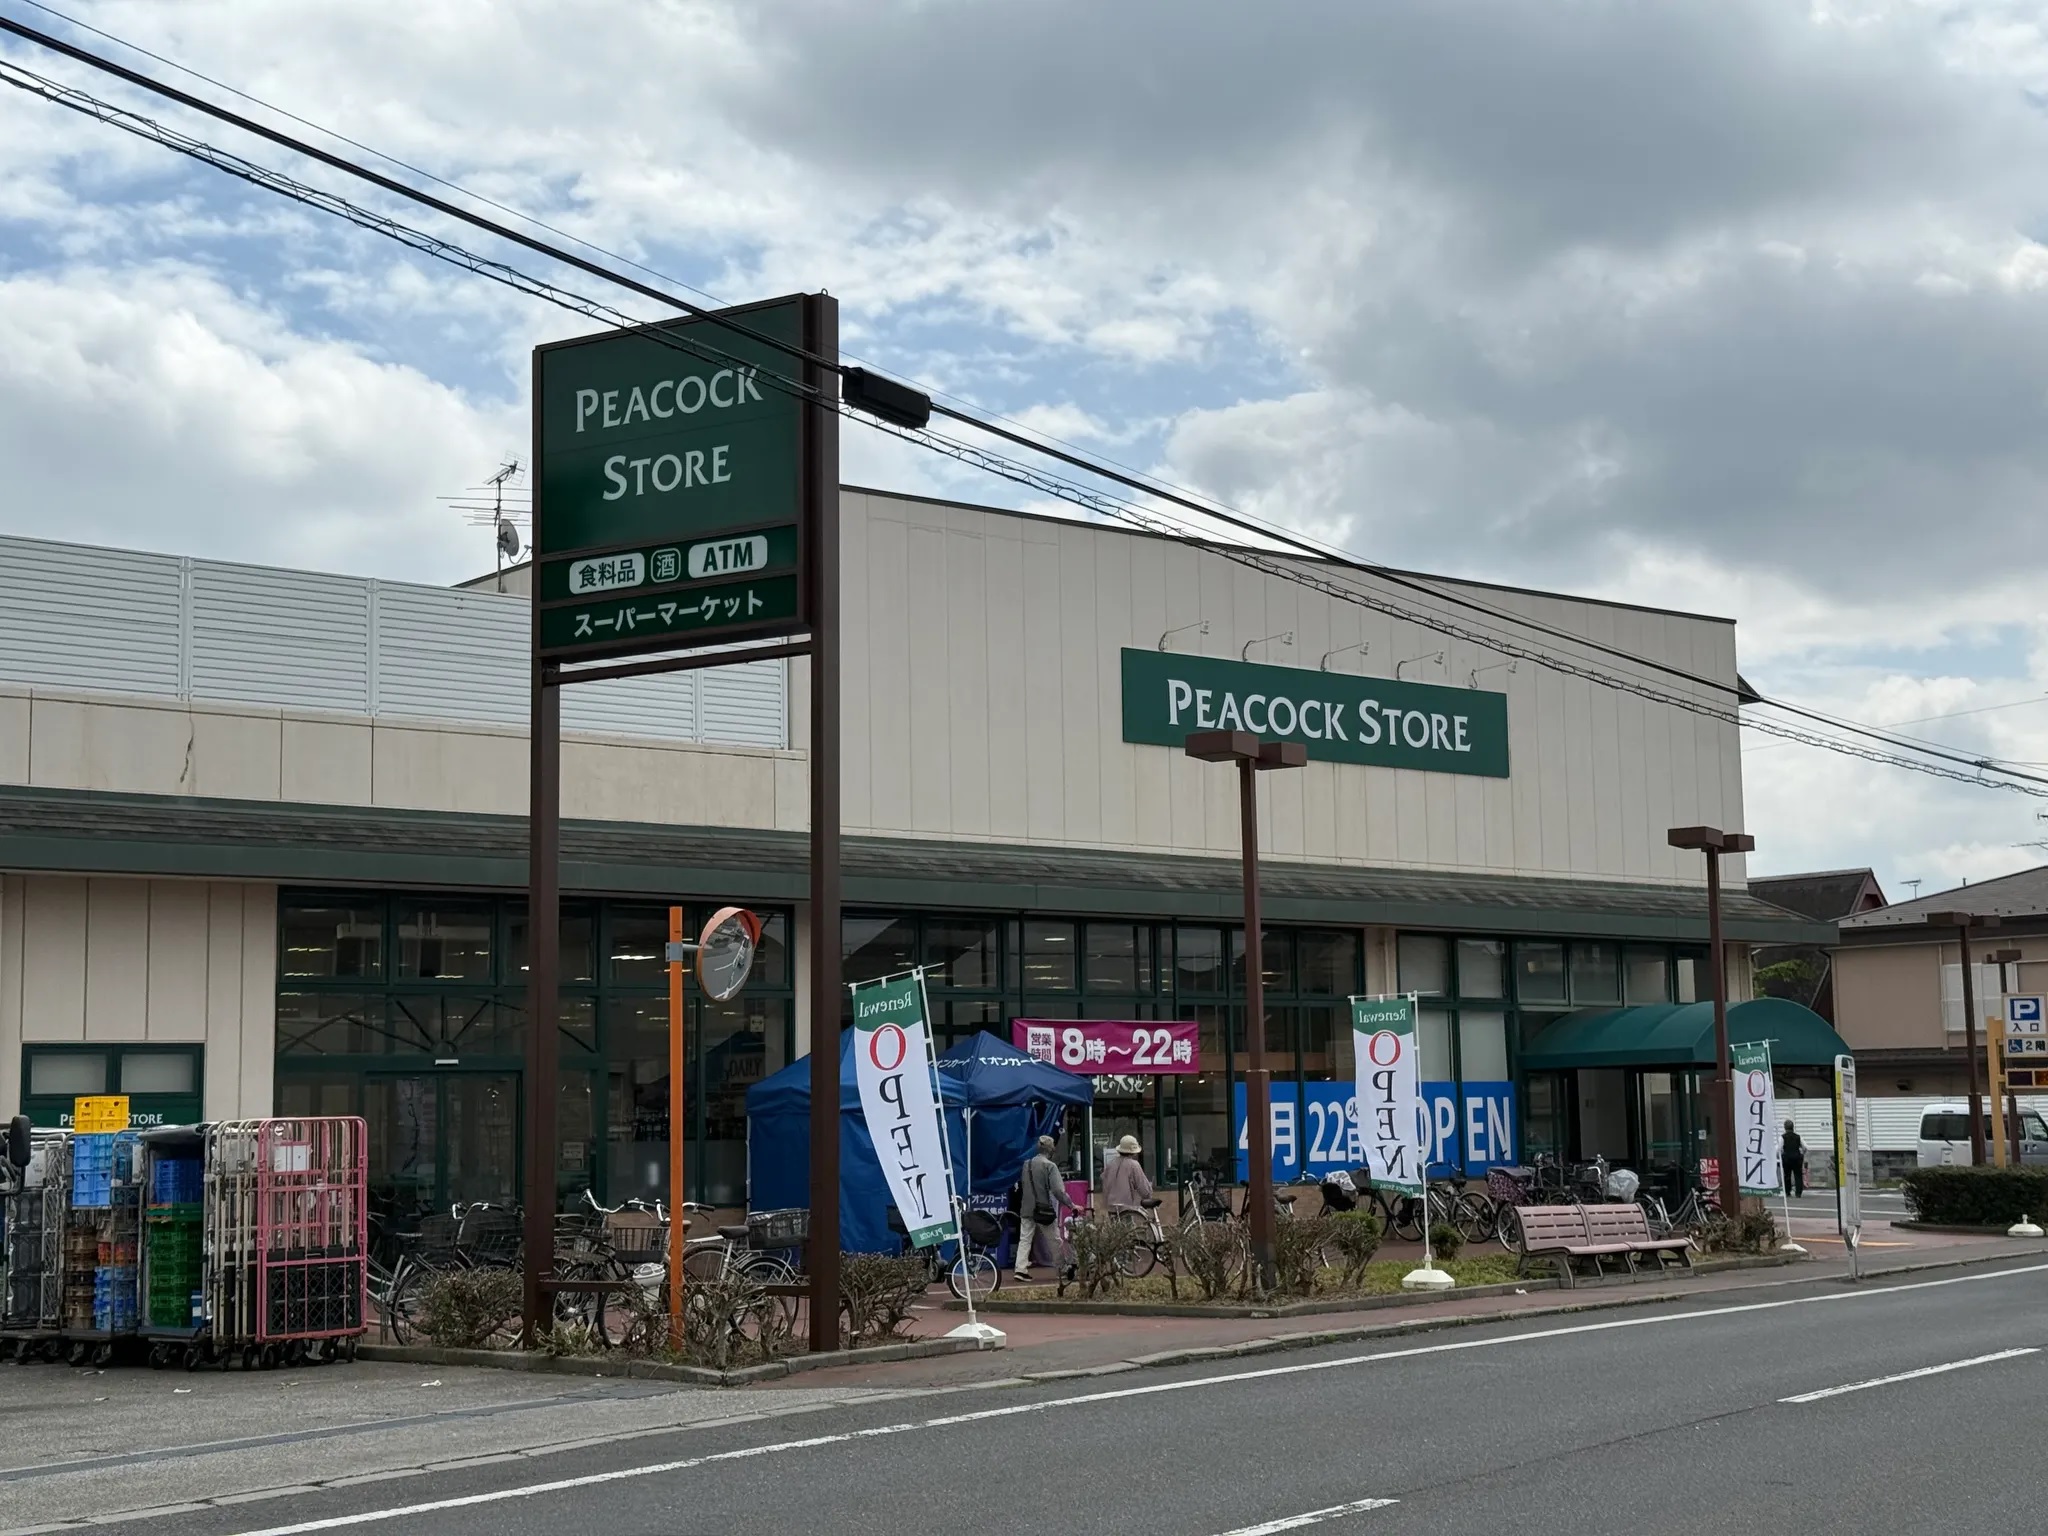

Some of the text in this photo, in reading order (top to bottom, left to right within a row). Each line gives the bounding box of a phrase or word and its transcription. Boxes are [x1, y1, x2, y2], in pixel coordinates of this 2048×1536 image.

[575, 364, 763, 432] PEACOCK
[603, 445, 731, 501] STORE
[656, 555, 676, 578] 酒
[702, 542, 753, 573] ATM
[578, 559, 636, 589] 食料品
[574, 590, 764, 638] スーパーマーケット
[1167, 679, 1472, 752] PEACOCK STORE
[2013, 1000, 2036, 1019] P
[1030, 1033, 1052, 1046] 営業
[2012, 1022, 2039, 1032] 入口
[1031, 1048, 1052, 1062] 時間
[2025, 1040, 2046, 1051] 2階
